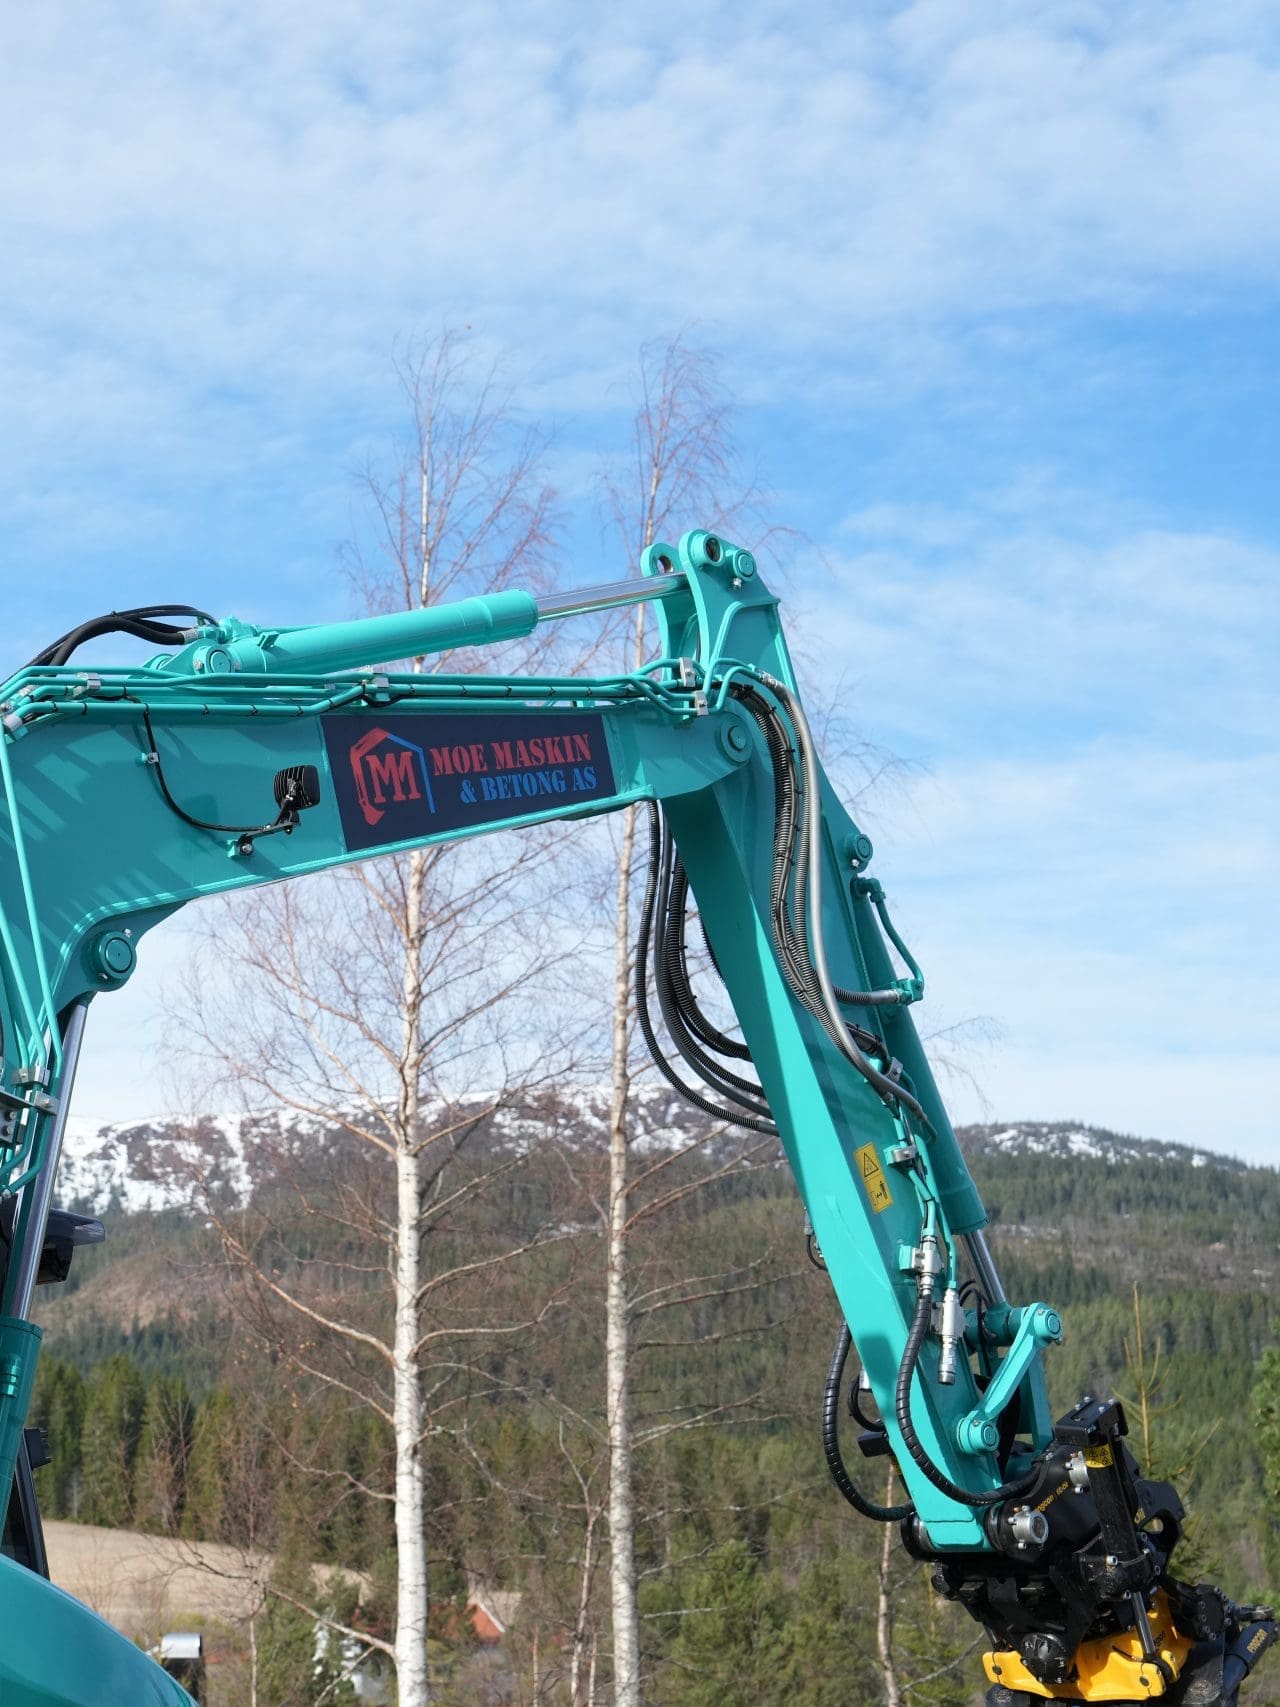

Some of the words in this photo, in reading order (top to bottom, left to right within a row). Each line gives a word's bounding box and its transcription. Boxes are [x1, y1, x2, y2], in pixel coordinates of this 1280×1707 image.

[429, 743, 488, 776] MOE
[490, 733, 592, 770] MASKIN
[460, 778, 477, 804] &
[480, 771, 566, 801] BETONG
[572, 766, 597, 791] AS
